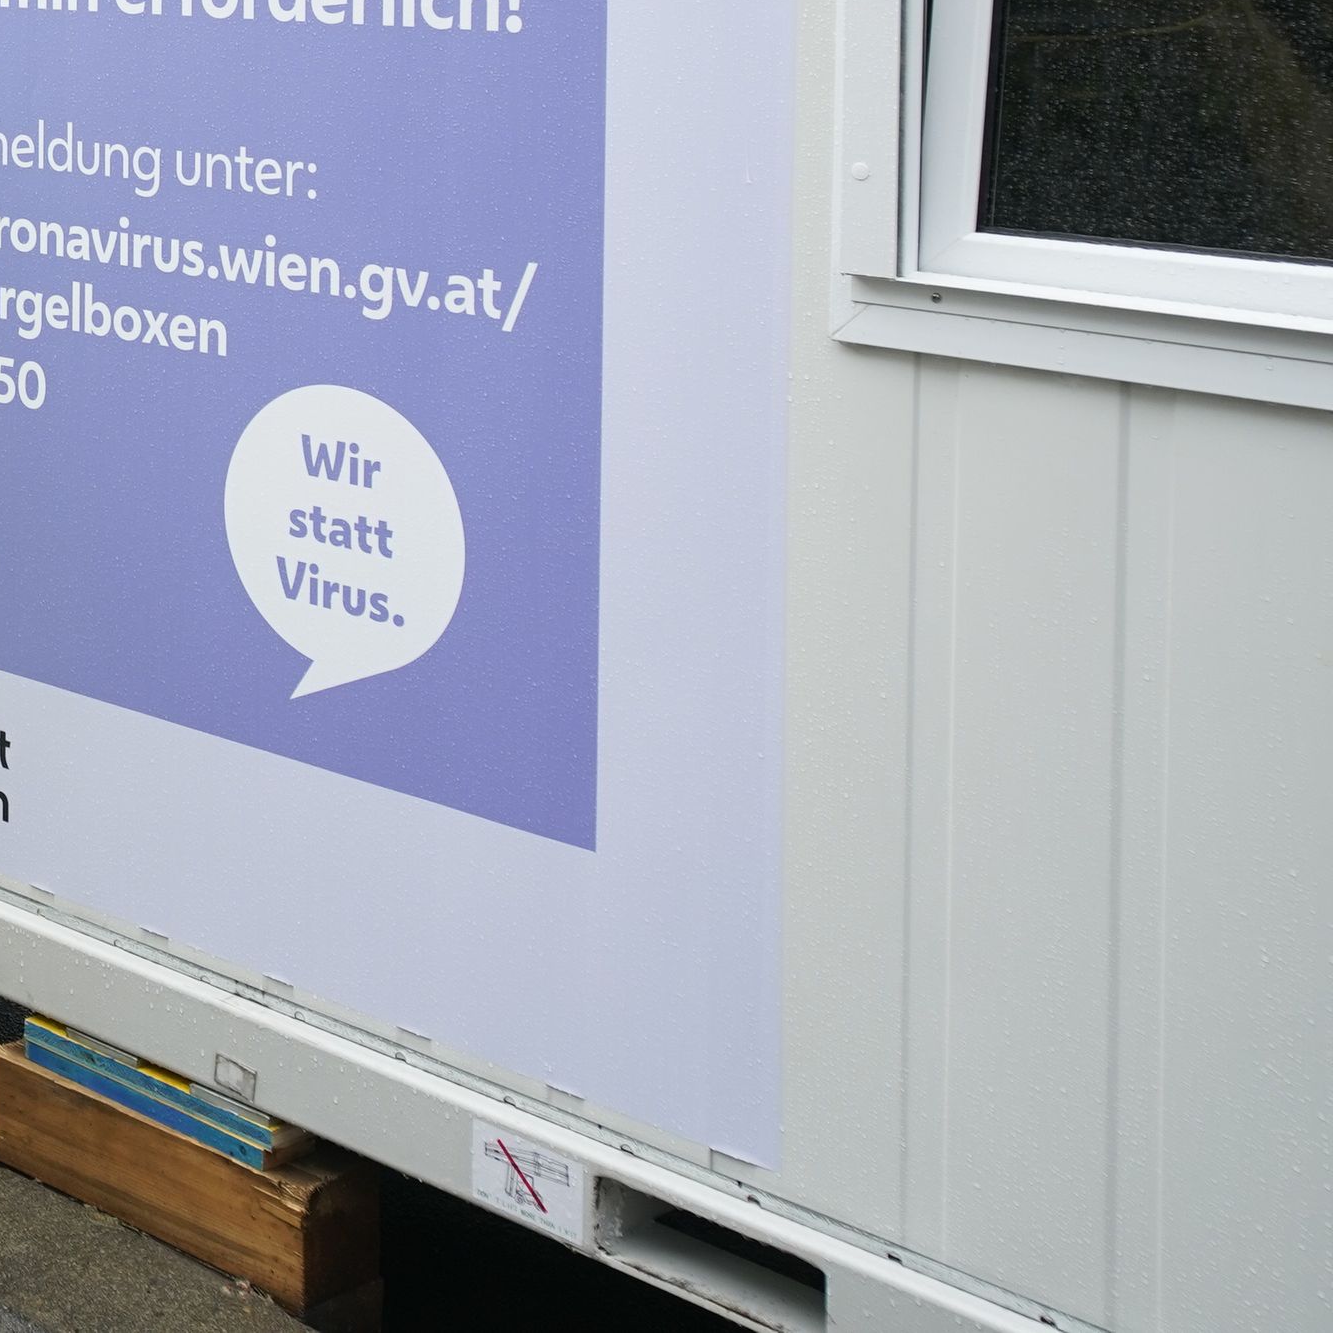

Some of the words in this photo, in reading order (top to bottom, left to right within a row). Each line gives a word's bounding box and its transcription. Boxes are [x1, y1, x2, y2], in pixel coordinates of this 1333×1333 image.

[176, 144, 318, 200] unter:
[301, 433, 382, 490] Wir
[289, 504, 394, 560] statt
[276, 555, 405, 628] Virus.
